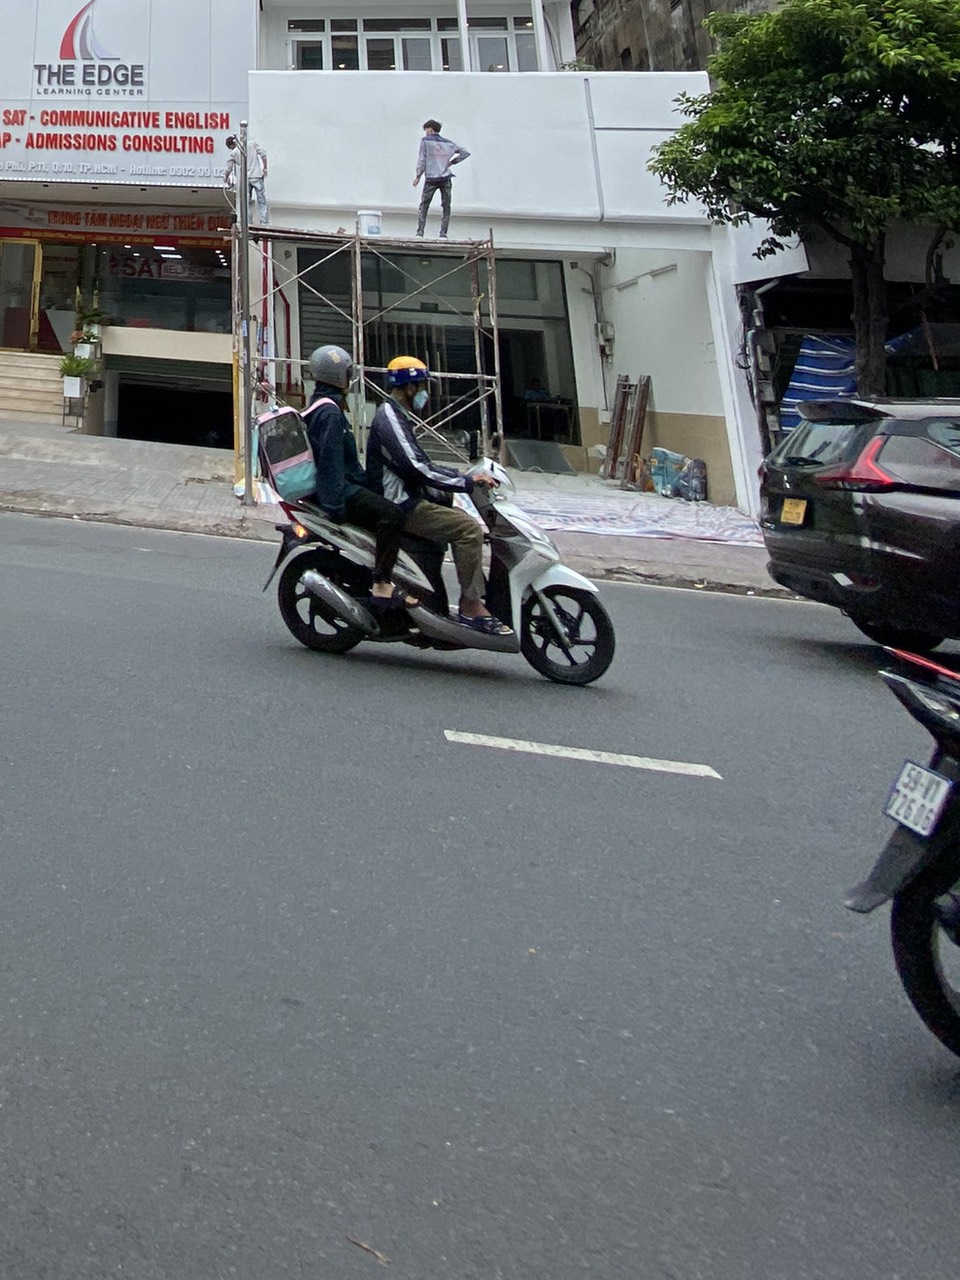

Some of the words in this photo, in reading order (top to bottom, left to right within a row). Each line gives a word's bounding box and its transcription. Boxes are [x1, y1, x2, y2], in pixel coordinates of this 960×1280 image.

[33, 64, 75, 86] THE
[82, 64, 144, 86] EDGE
[96, 88, 144, 96] CENTER
[2, 109, 27, 126] SAT
[40, 110, 160, 128] COMMUNICATIVE
[165, 112, 230, 130] ENGLISH
[25, 132, 117, 151] ADMISSIONS
[122, 134, 214, 153] CONSULTING
[169, 165, 195, 177] 0902
